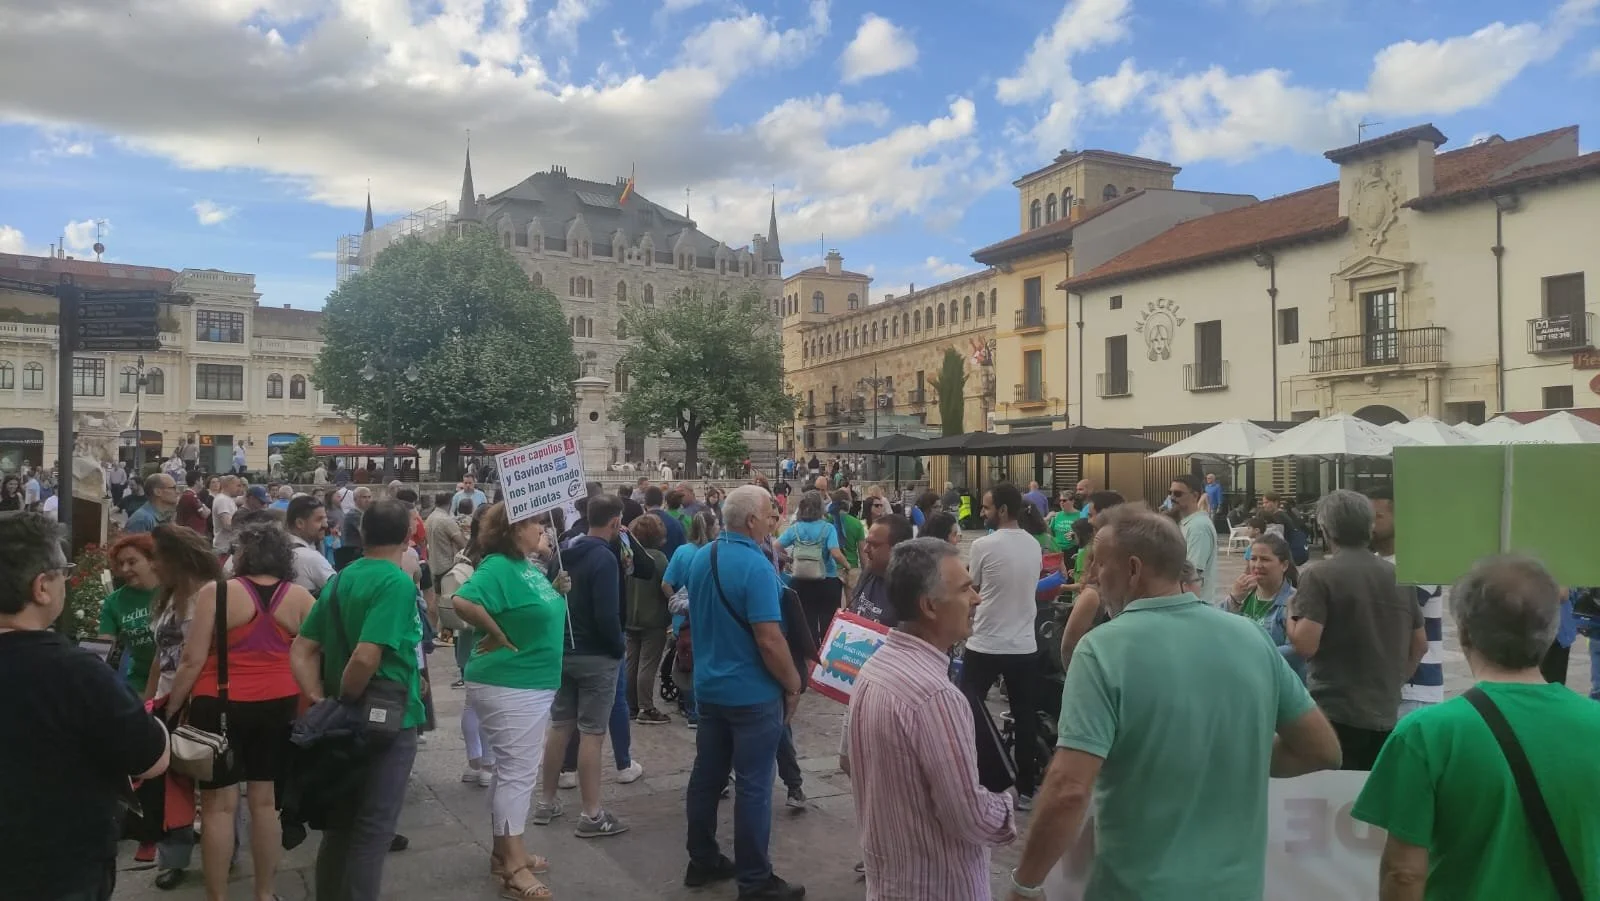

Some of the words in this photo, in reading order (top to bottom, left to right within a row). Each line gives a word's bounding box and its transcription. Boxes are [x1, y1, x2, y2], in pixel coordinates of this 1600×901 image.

[1135, 297, 1186, 333] MARCELA
[503, 454, 526, 468] Entre
[528, 442, 563, 460] capullos
[505, 475, 512, 486] y
[514, 461, 554, 481] Gaviotas
[509, 487, 526, 500] nos
[528, 479, 546, 493] han
[548, 468, 580, 486] tomado
[512, 502, 528, 517] por
[530, 490, 561, 508] idiotas
